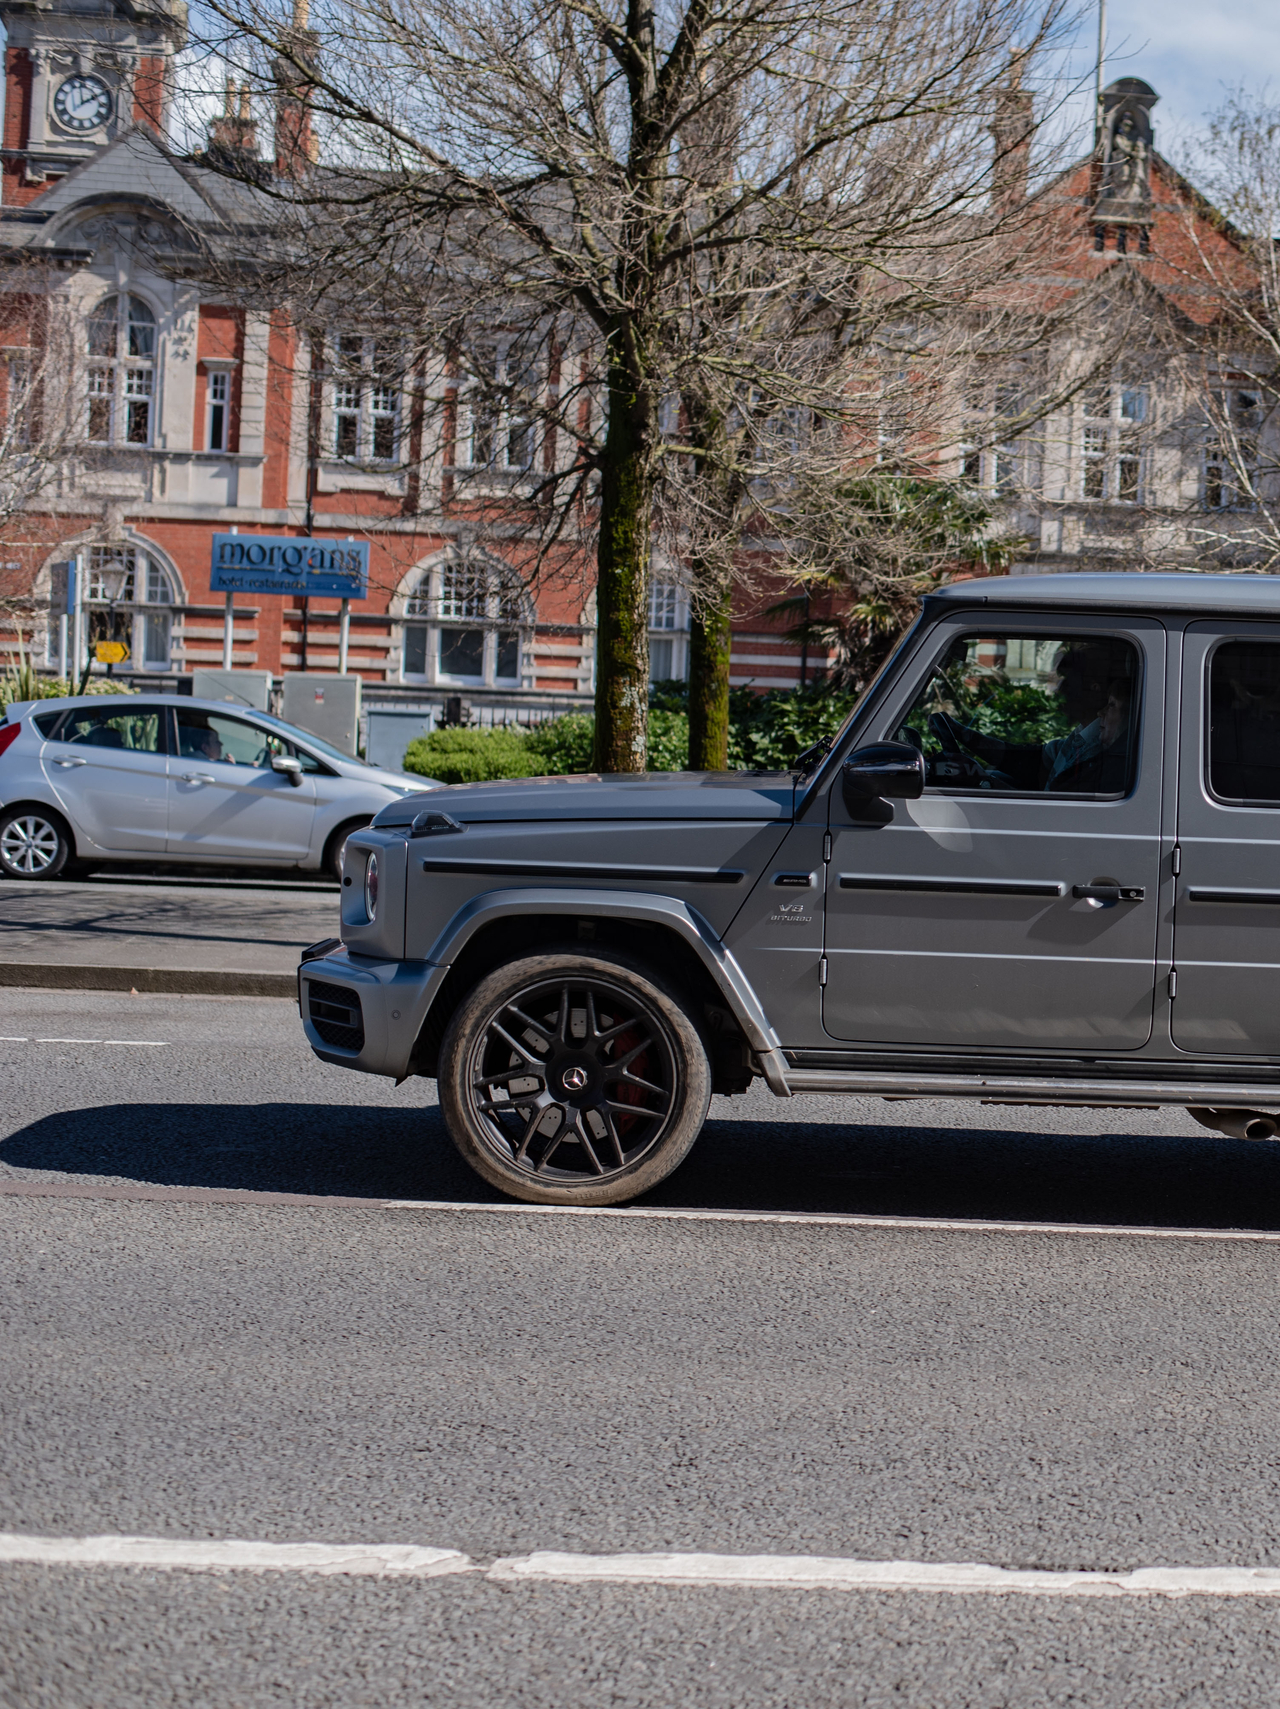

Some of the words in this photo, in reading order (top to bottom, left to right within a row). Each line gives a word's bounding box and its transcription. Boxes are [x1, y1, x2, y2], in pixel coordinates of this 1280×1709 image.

[218, 542, 363, 575] morgans
[218, 576, 244, 587] hotel
[779, 904, 804, 912] V8
